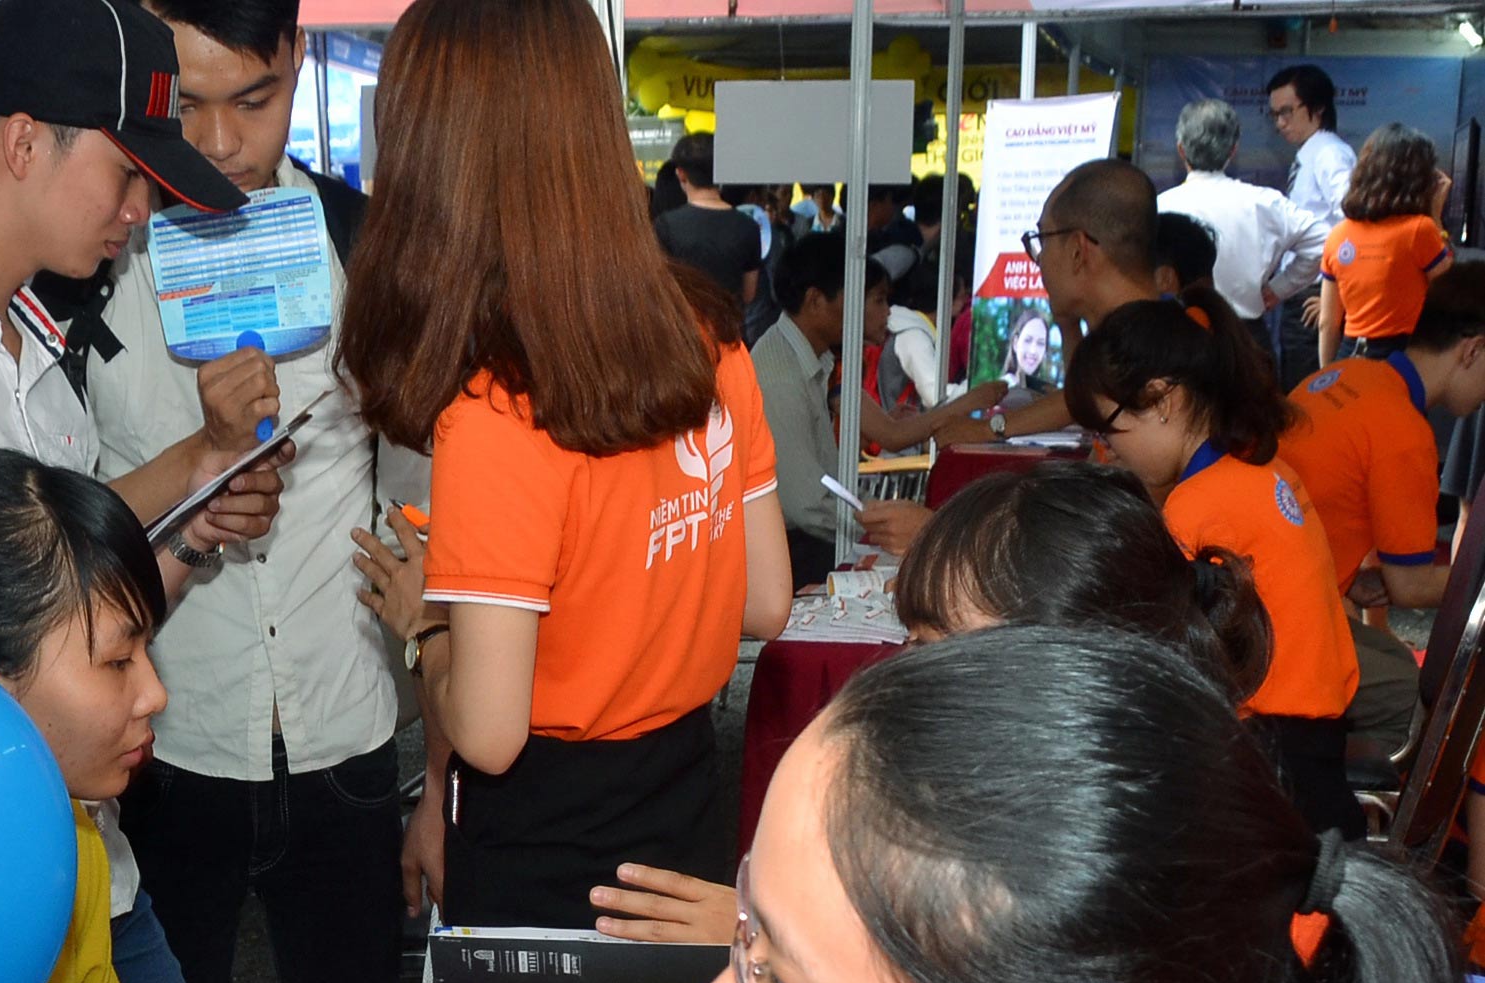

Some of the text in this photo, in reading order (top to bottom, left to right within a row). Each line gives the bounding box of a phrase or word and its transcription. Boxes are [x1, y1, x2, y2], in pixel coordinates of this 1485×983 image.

[1006, 128, 1026, 138] CAO
[681, 487, 709, 514] TIN
[645, 511, 709, 571] FPT
